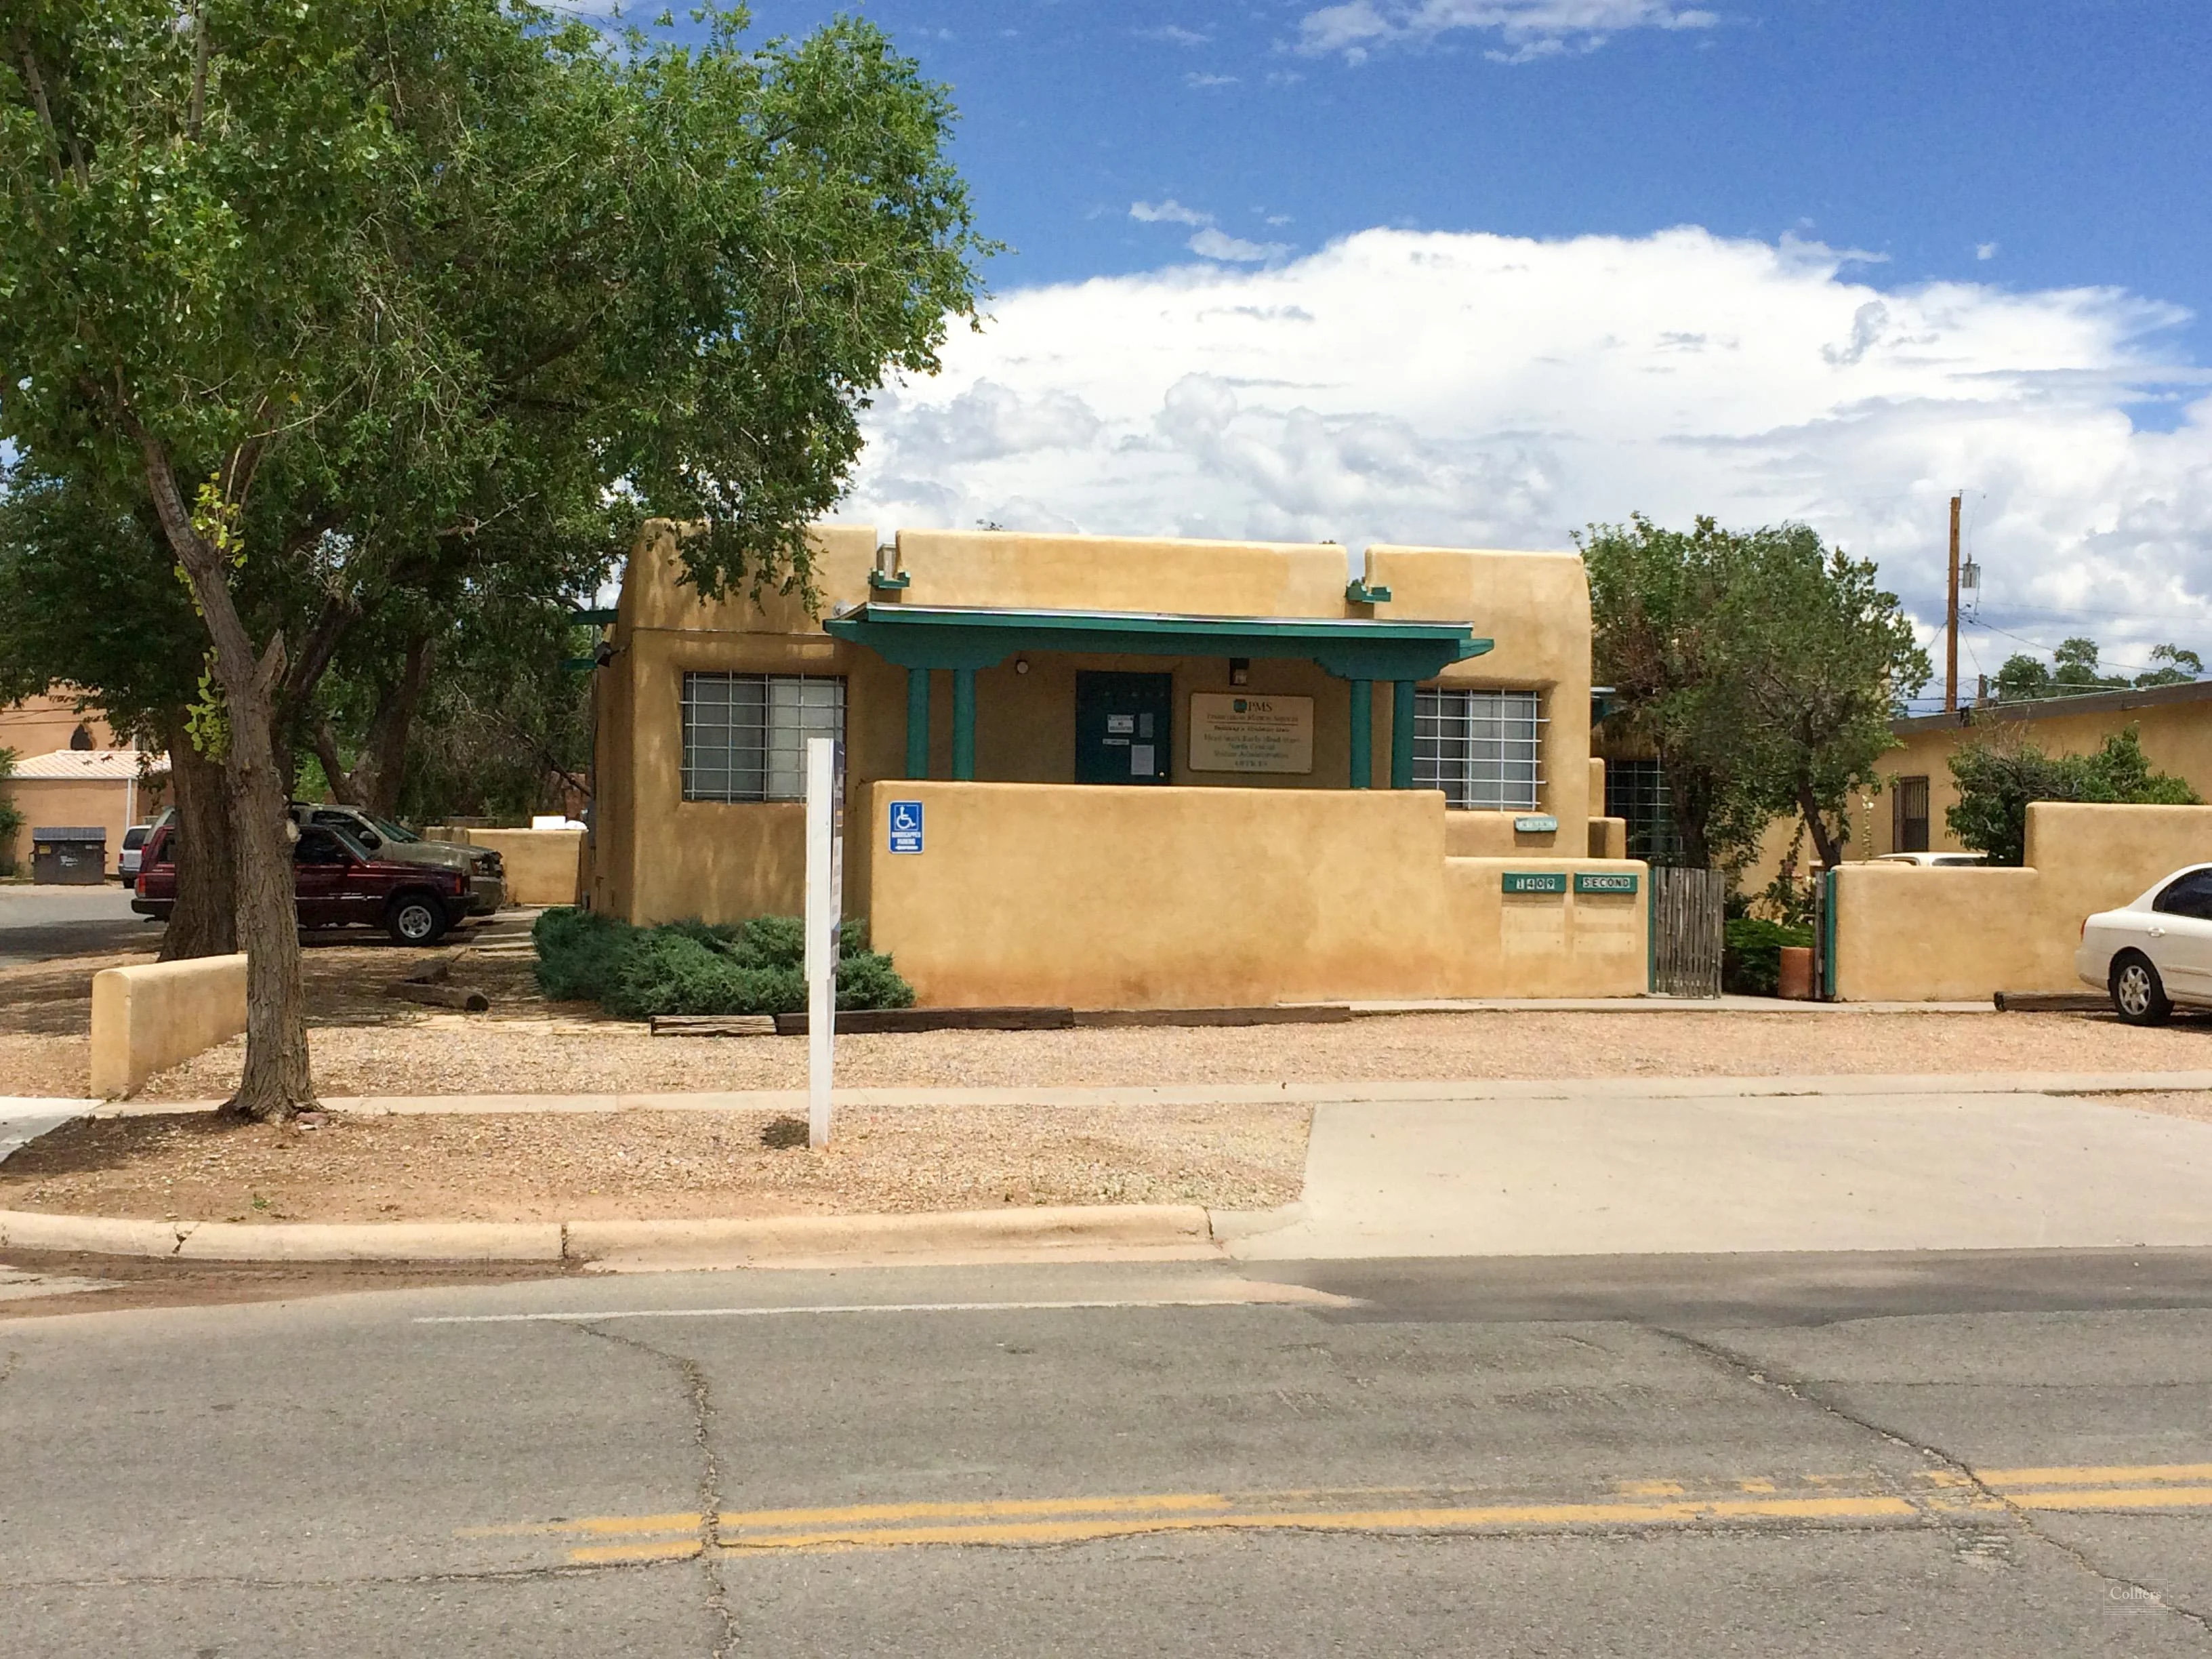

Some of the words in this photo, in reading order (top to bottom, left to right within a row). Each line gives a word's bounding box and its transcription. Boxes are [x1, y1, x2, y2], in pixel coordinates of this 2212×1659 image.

[1248, 701, 1273, 712] PMS
[1518, 878, 1554, 888] 1409
[1584, 877, 1629, 888] SECOND
